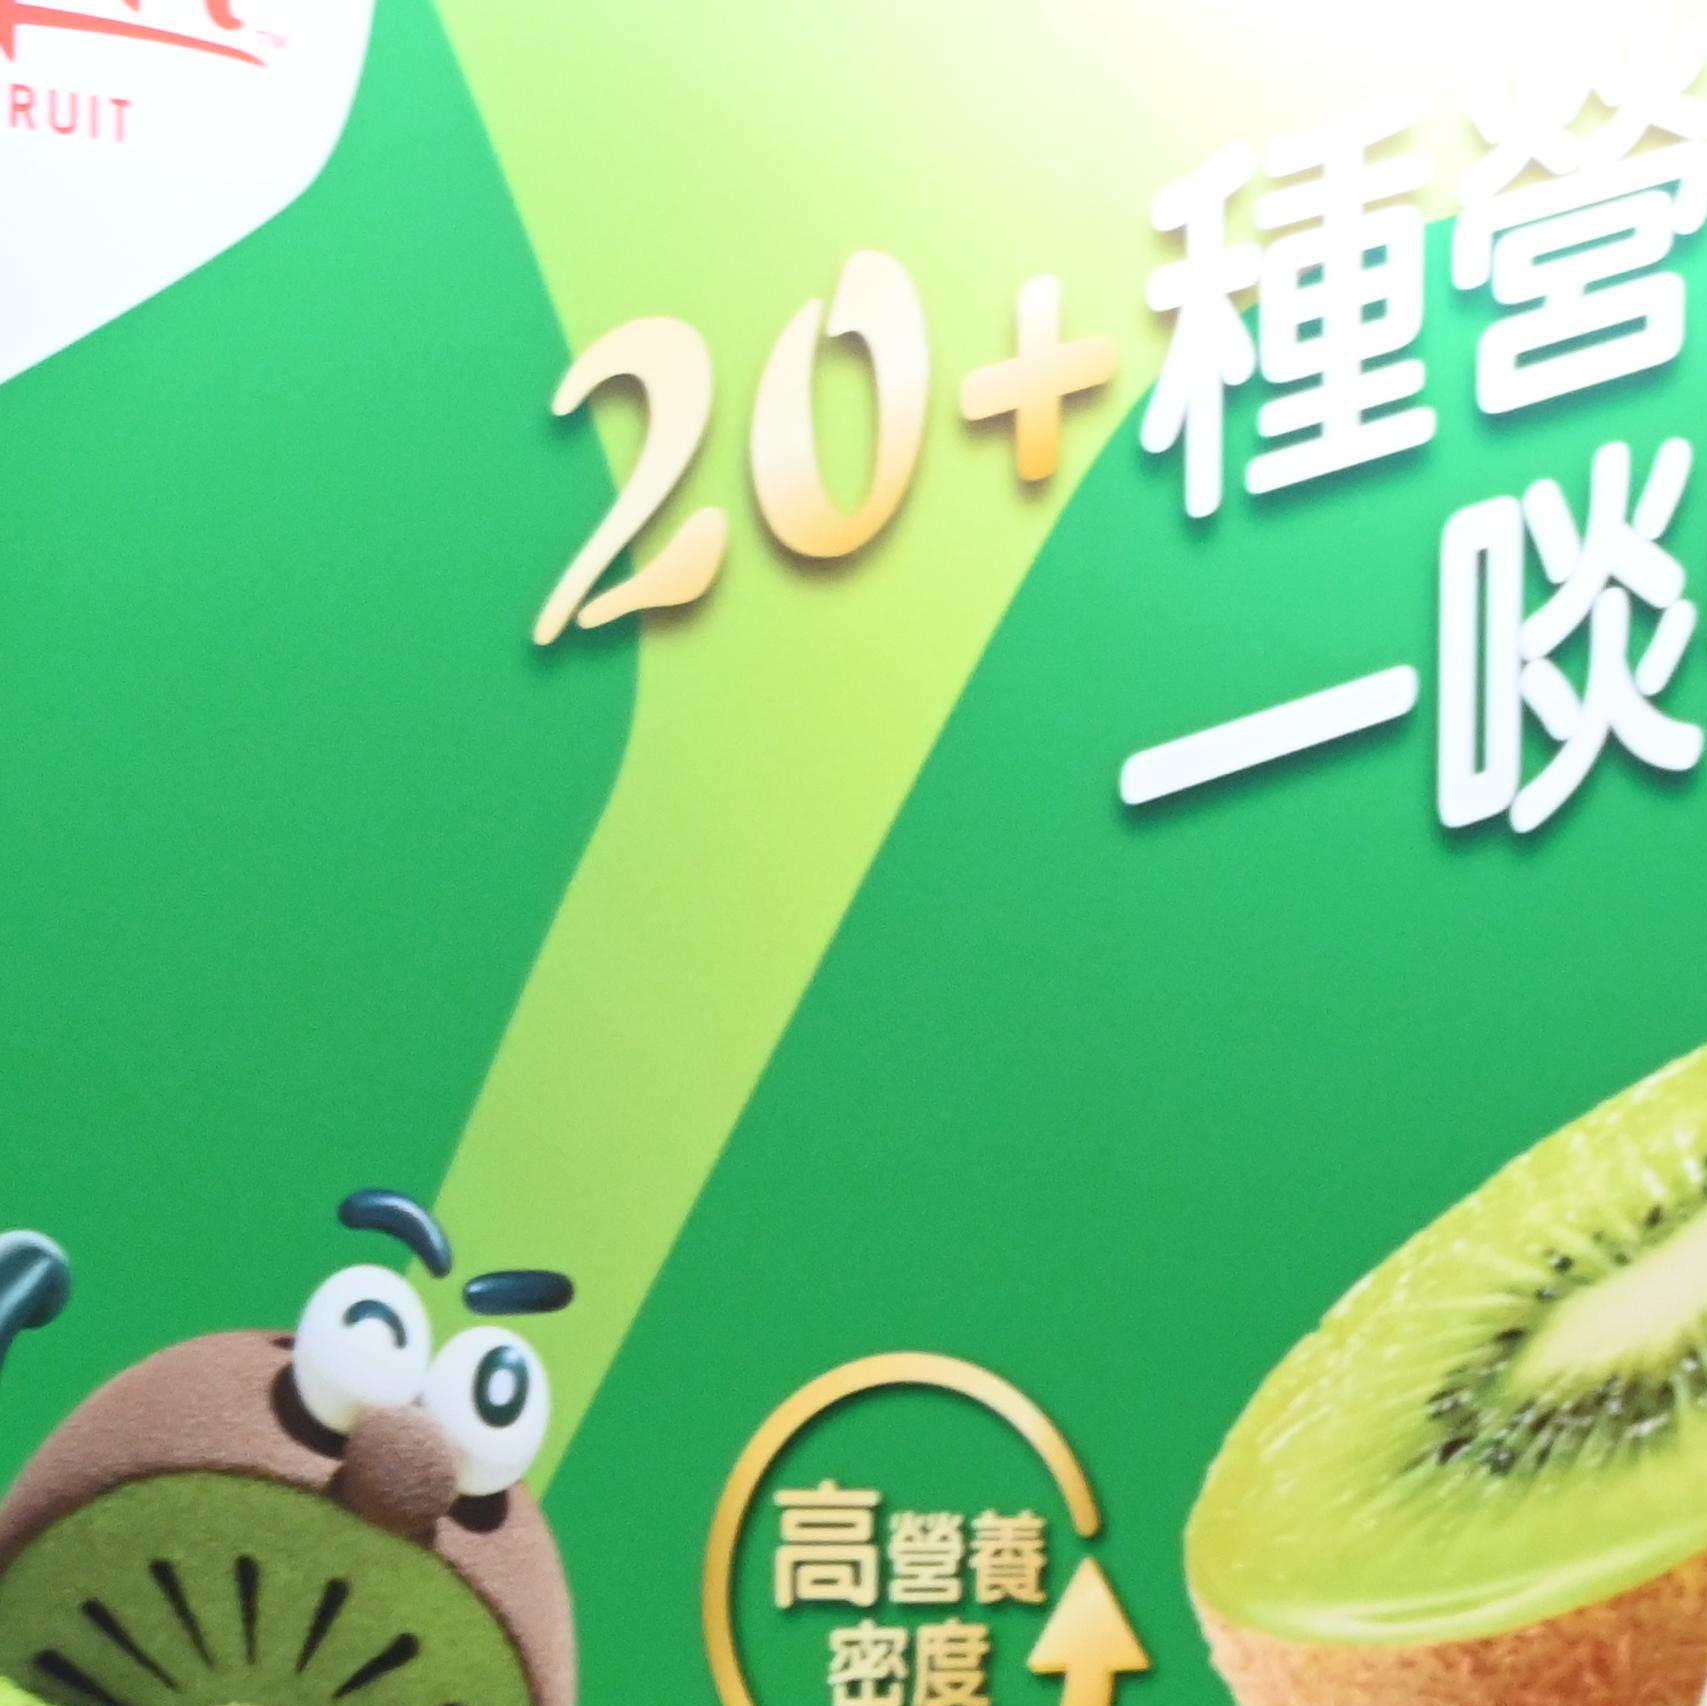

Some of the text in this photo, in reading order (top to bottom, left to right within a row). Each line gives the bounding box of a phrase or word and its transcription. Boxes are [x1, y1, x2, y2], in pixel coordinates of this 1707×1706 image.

[2, 82, 132, 143] RUIT
[772, 1478, 1047, 1609] 高營養
